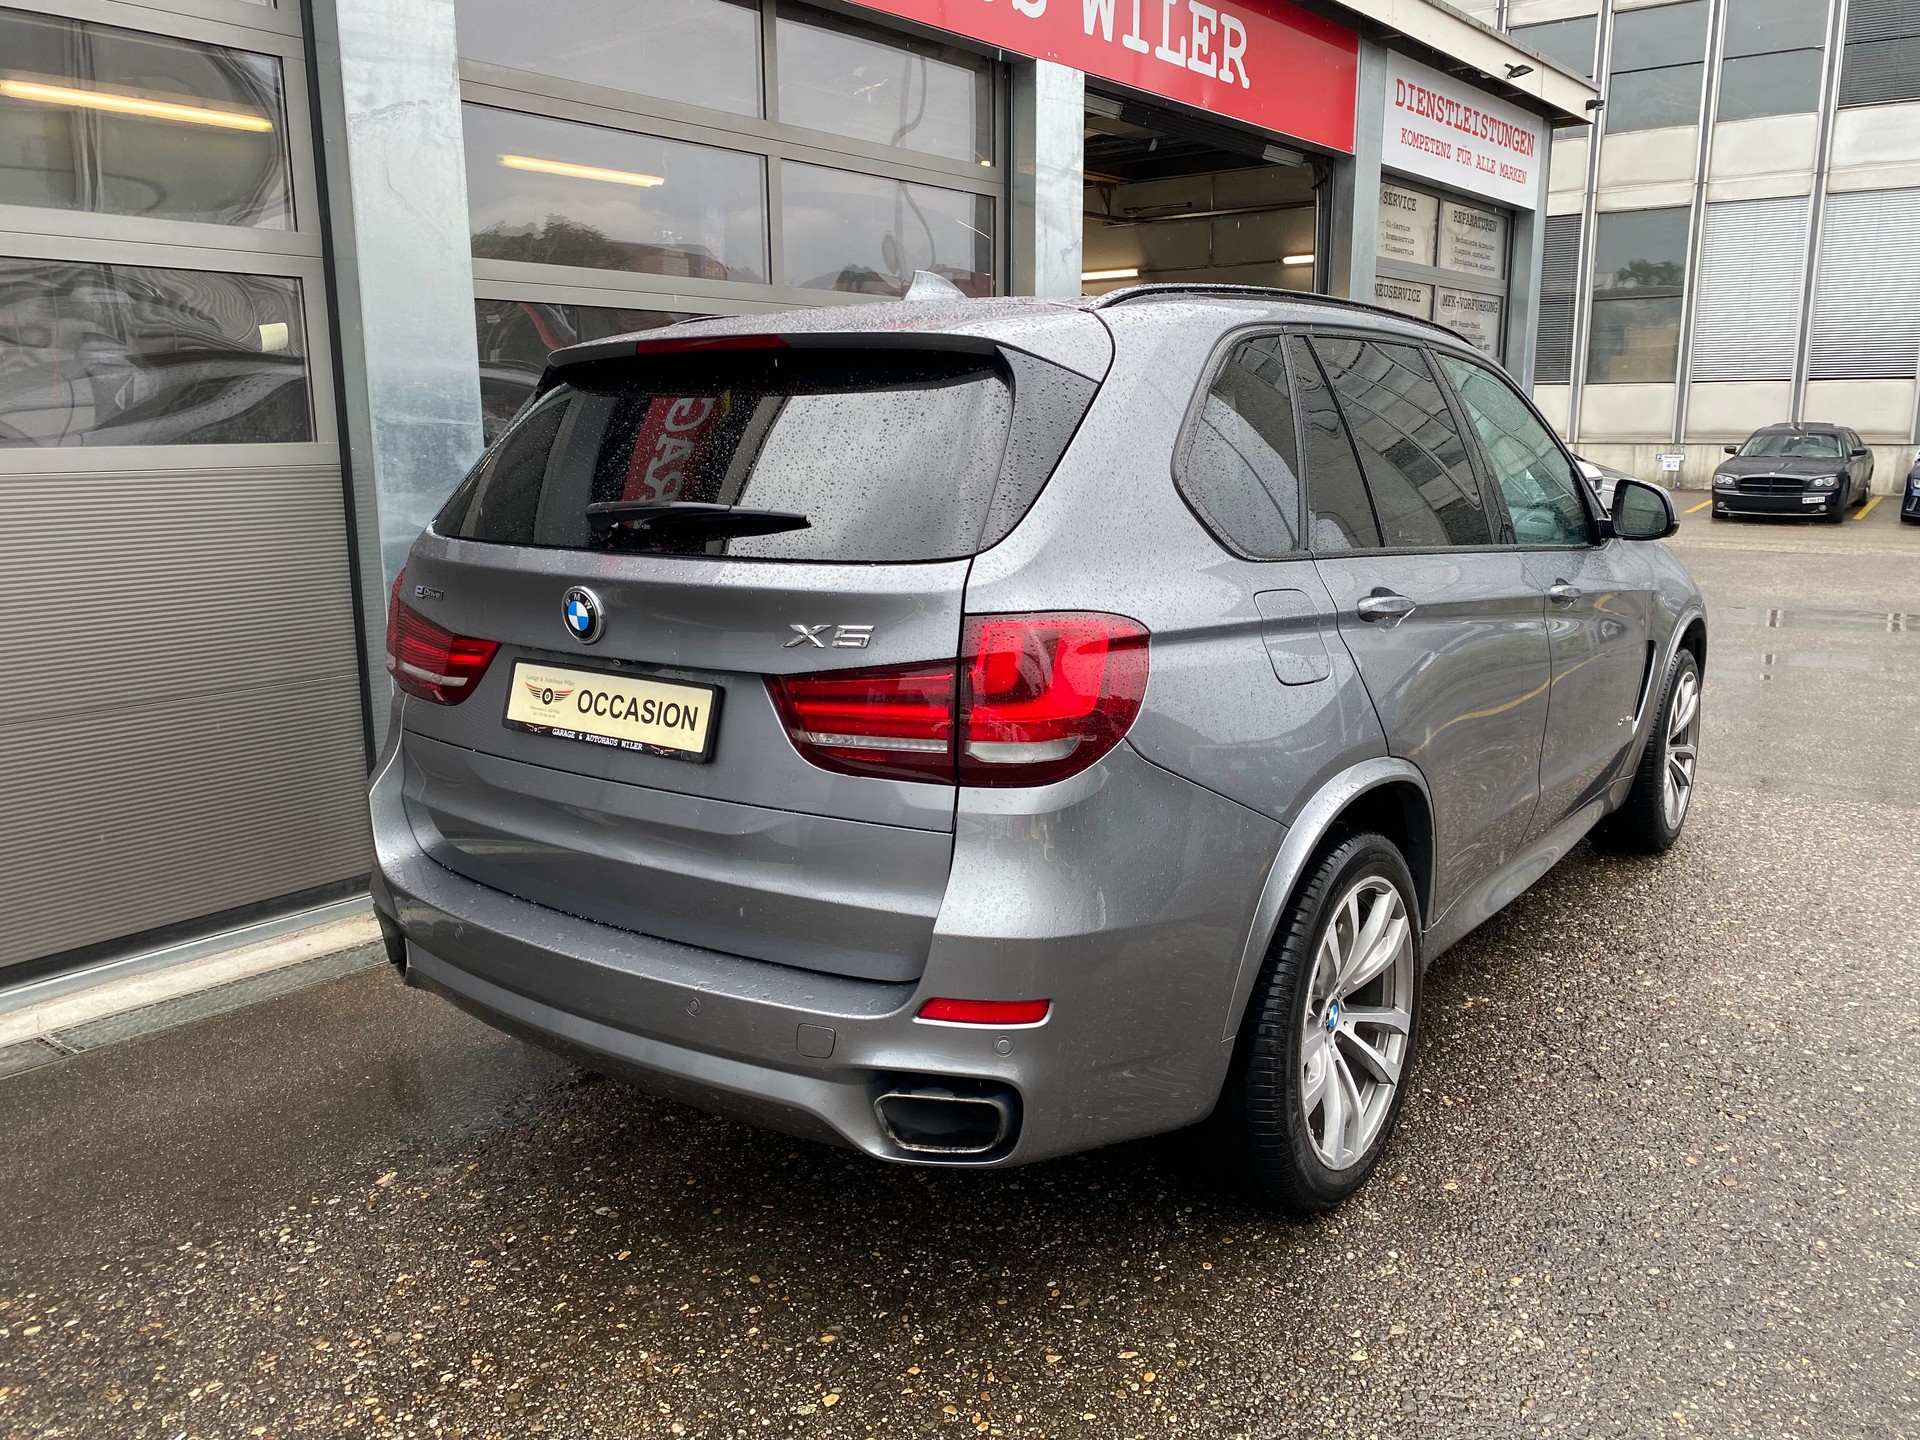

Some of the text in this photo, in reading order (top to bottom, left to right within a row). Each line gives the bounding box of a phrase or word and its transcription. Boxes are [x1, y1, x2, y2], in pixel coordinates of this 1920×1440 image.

[1082, 0, 1250, 89] WILER
[1395, 78, 1535, 157] DIENSTLEISTUNGEN
[1401, 127, 1527, 184] KOMPETENZ FÜR ALLE MARKEN
[1382, 190, 1417, 211] SERVICE
[1453, 210, 1498, 232] REPARATUREN
[565, 592, 593, 610] BMW
[781, 624, 875, 648] X5
[577, 689, 699, 731] OCCASION
[552, 728, 576, 739] GARAGE
[585, 733, 619, 747] AUTOHAUS
[621, 740, 643, 751] WILER
